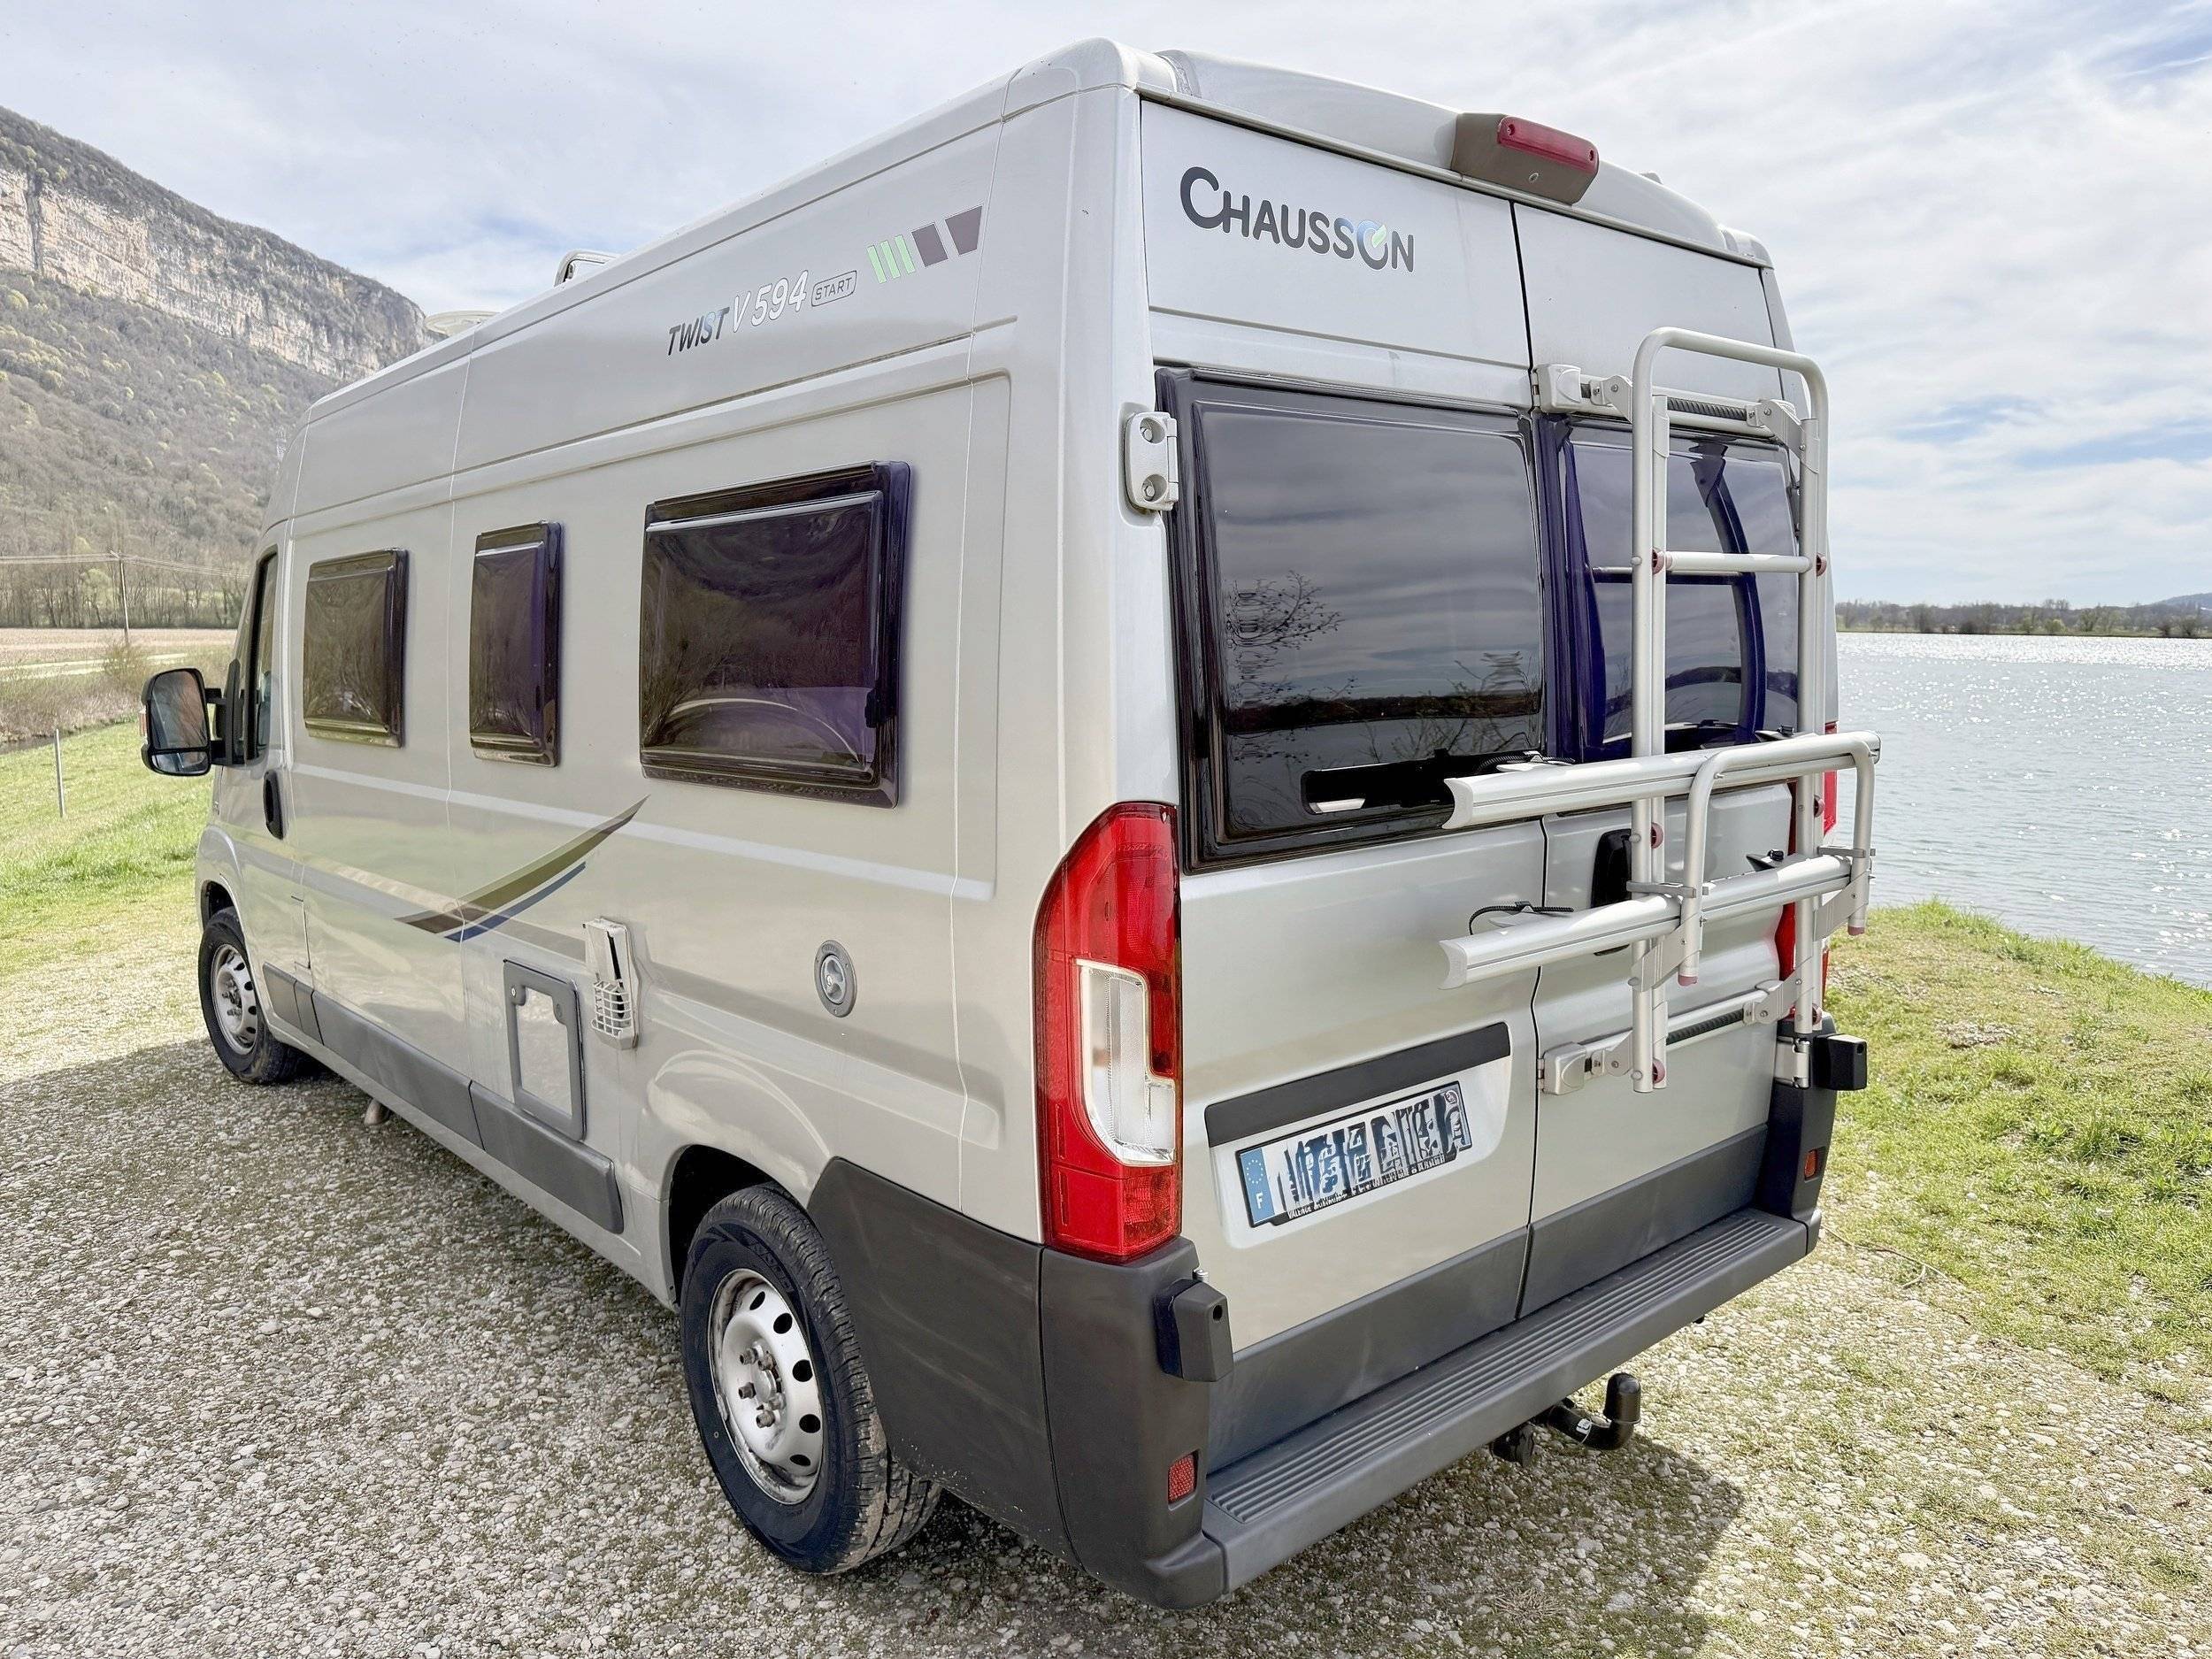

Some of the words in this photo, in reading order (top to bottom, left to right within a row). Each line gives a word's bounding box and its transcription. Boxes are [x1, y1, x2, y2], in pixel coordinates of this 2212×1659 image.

[1179, 165, 1415, 273] CHAUSSON
[667, 306, 730, 356] TWIST
[733, 290, 752, 334] V
[750, 269, 809, 326] 594
[815, 277, 852, 301] START
[1256, 1192, 1263, 1210] F
